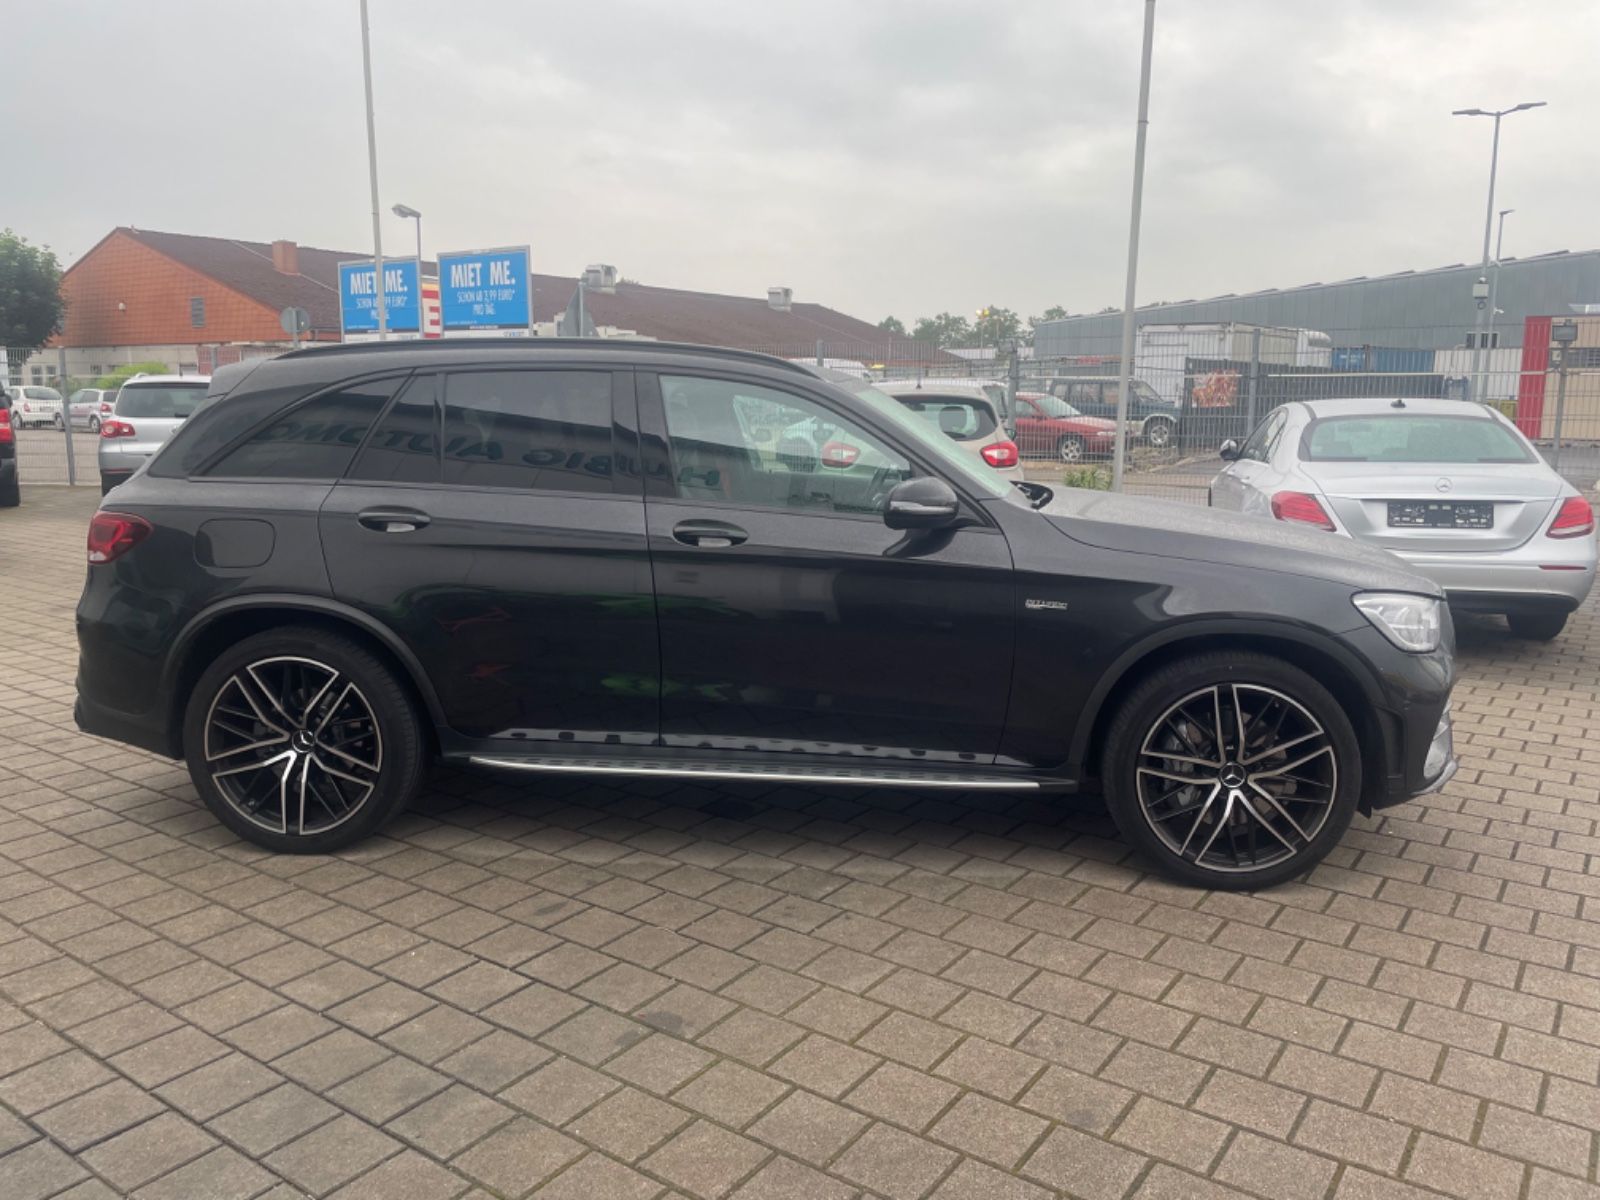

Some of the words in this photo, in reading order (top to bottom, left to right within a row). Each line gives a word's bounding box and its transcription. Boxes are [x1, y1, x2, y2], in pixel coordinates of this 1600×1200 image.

[350, 271, 377, 295] MIET
[385, 269, 408, 293] ME.
[451, 263, 482, 288] MIET
[490, 260, 516, 286] ME.
